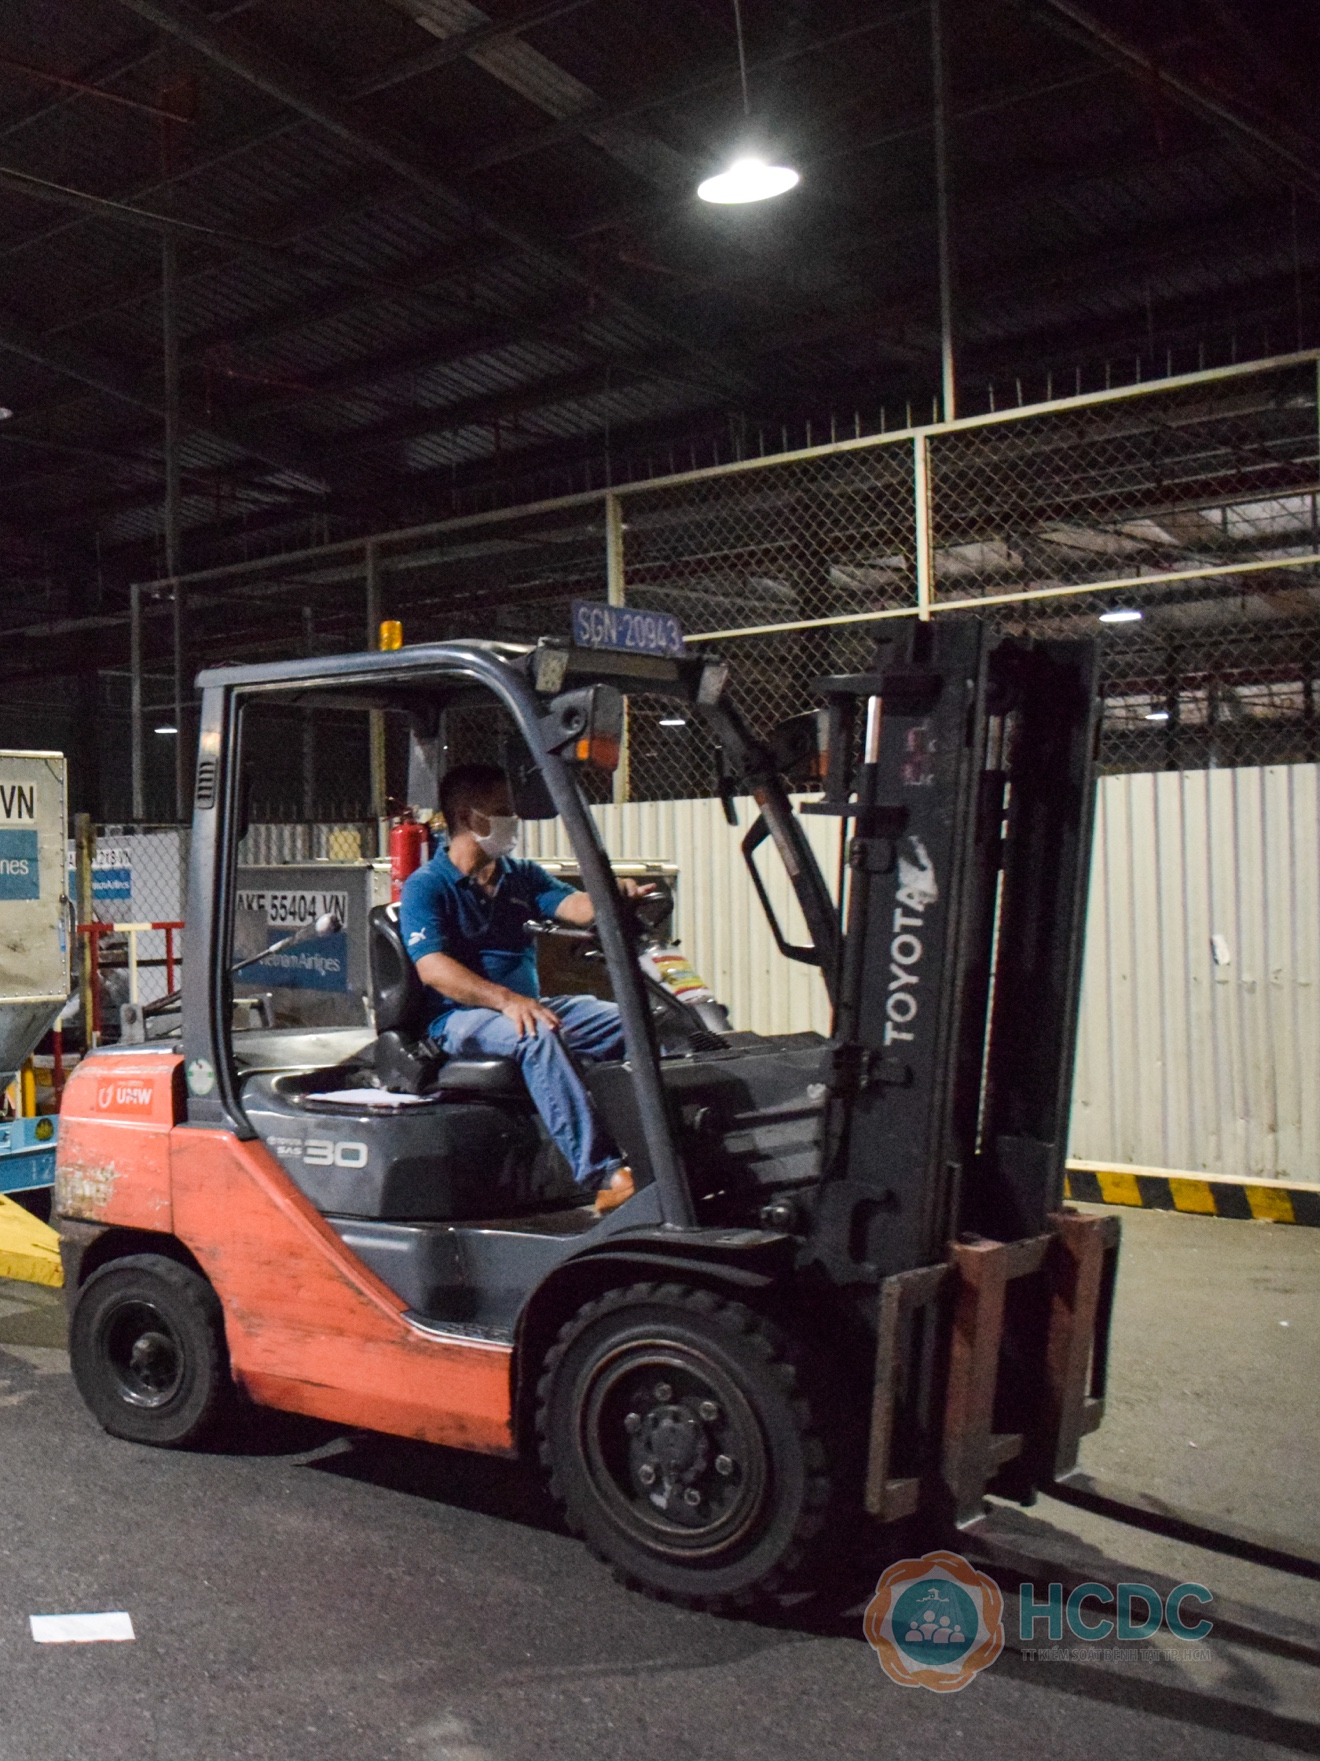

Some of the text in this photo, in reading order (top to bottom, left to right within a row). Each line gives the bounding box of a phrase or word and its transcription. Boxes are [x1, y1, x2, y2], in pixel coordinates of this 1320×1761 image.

[0, 785, 34, 819] VN
[270, 894, 317, 922] 55404
[883, 886, 925, 1046] TOYOTA
[116, 1087, 153, 1105] UMW
[303, 1139, 369, 1169] 30
